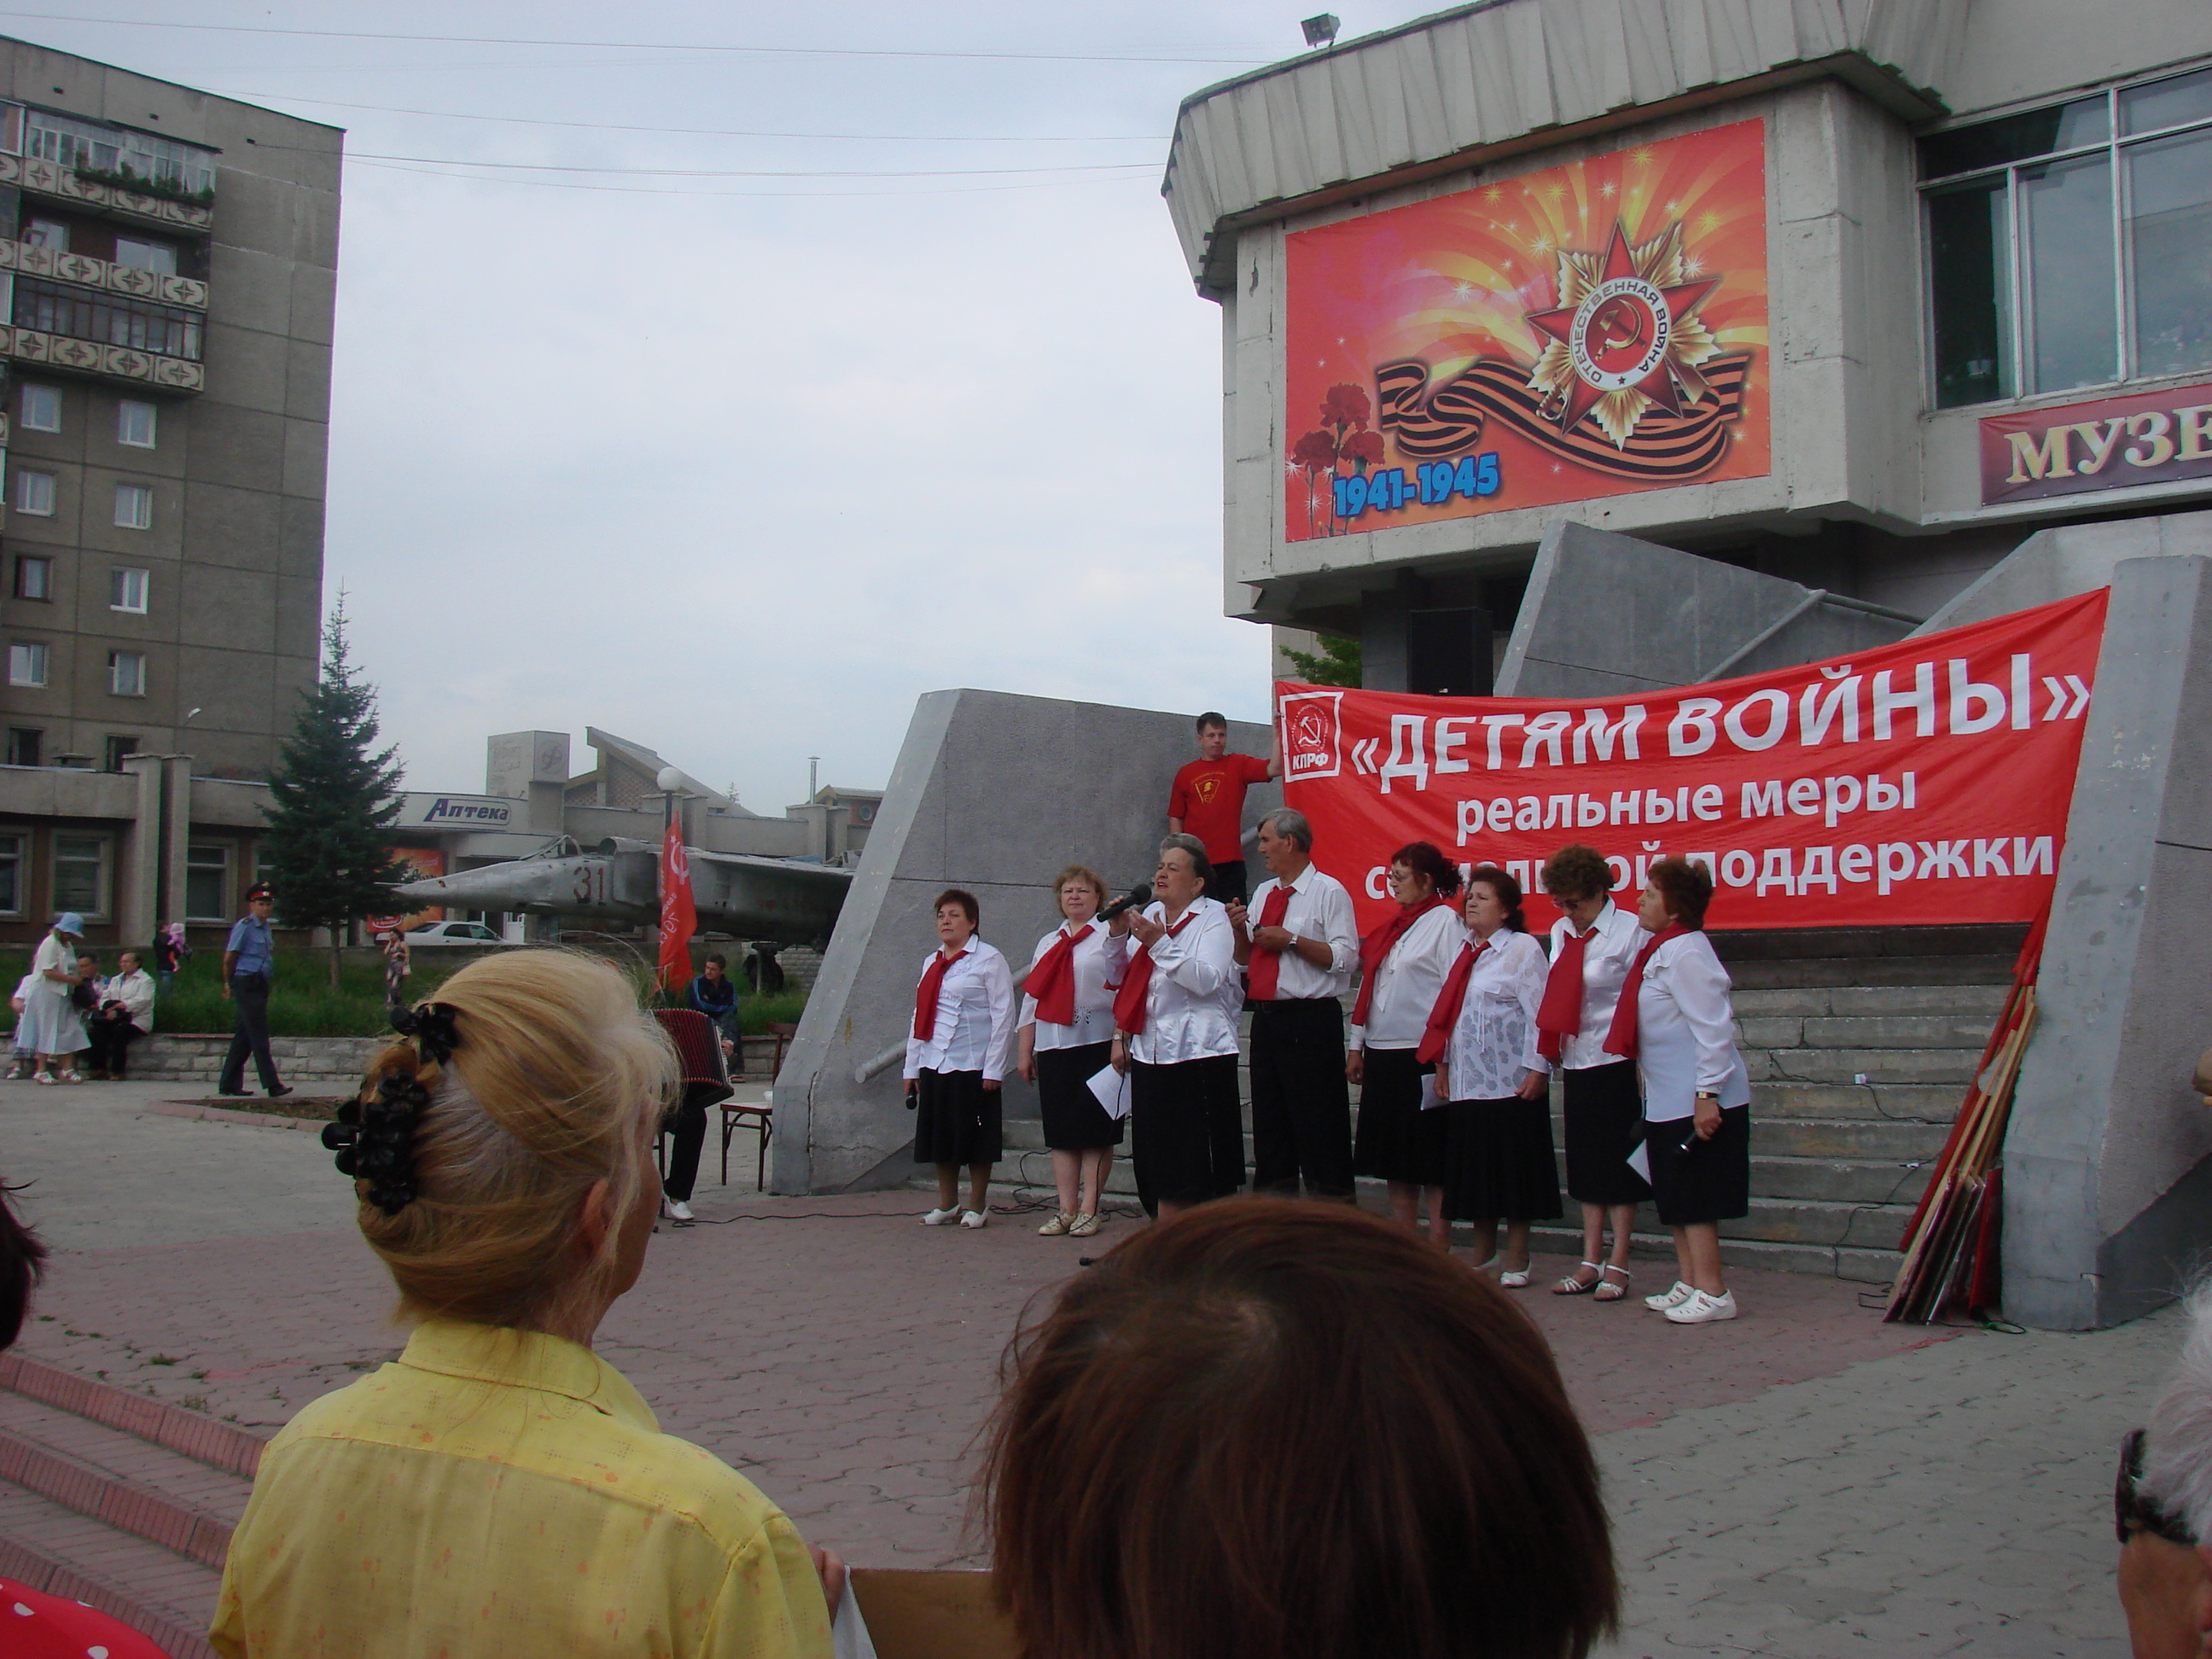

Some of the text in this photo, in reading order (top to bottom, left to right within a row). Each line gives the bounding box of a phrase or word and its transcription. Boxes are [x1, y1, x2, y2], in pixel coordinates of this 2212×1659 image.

[1574, 281, 1660, 383] ОТЕЧЕСТВЕННАЯ
[2004, 404, 2212, 484] МУЗЕ
[1333, 452, 1499, 517] 1941-1945
[1351, 705, 1647, 795] «ДЕТЯМ
[1668, 653, 2091, 758] ВОЙНЫ»
[1293, 753, 1329, 770] КПРФ
[423, 799, 509, 822] Аптека
[1457, 771, 1917, 847] реальные меры
[573, 866, 604, 903] 31
